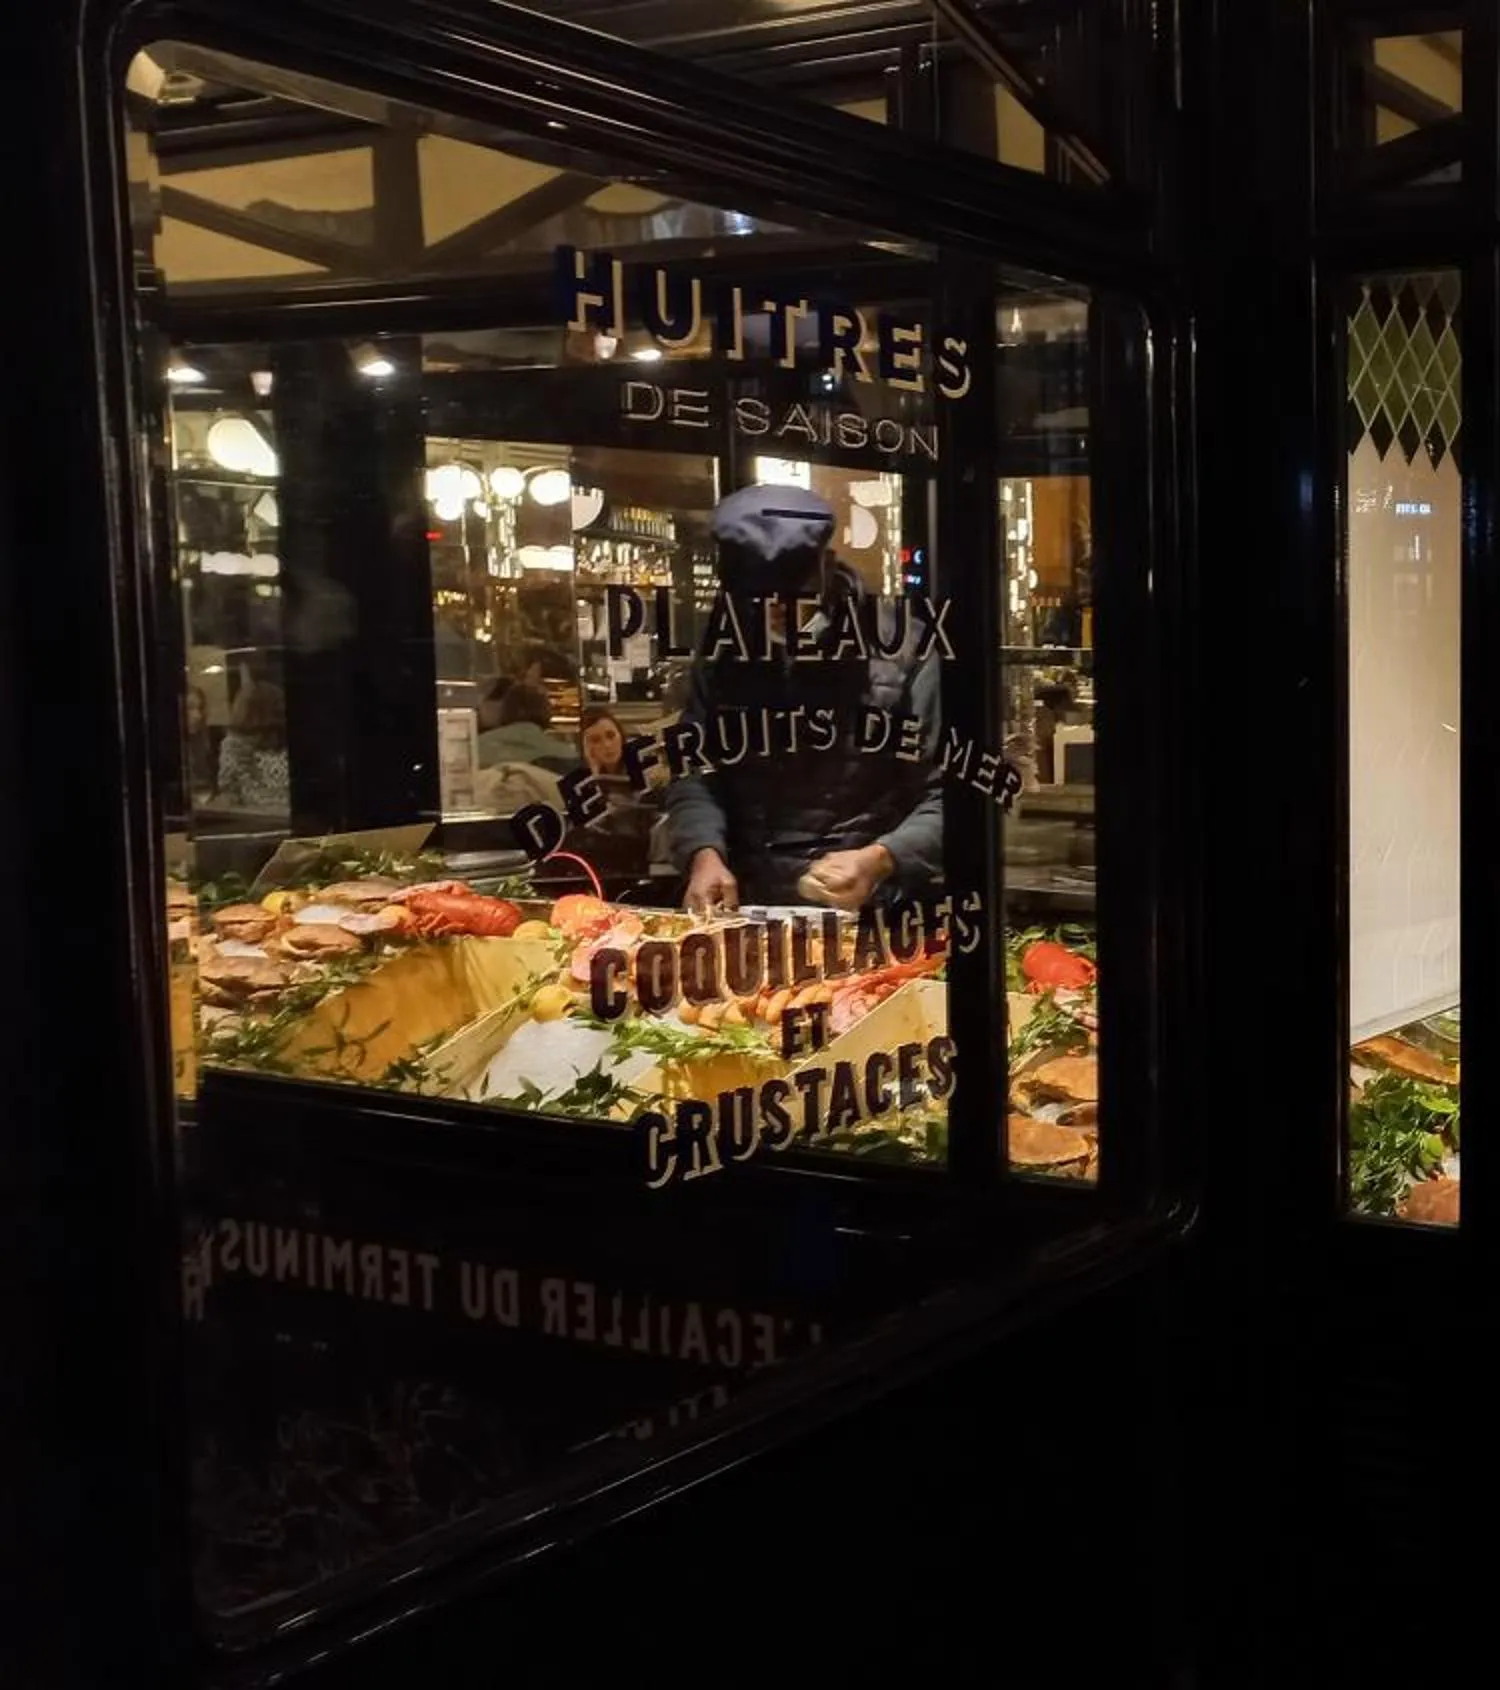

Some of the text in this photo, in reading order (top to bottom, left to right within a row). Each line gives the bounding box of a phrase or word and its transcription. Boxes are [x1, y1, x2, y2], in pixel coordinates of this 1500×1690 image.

[554, 245, 972, 400] HUITRES
[621, 381, 940, 462] DE SAISON
[606, 585, 957, 663] PLATEAUX
[511, 704, 1024, 863] DE FRUITS DE MER
[589, 890, 984, 1021] COQUILLAGES
[780, 1002, 832, 1060] ET
[634, 1035, 959, 1190] CRUSTACES
